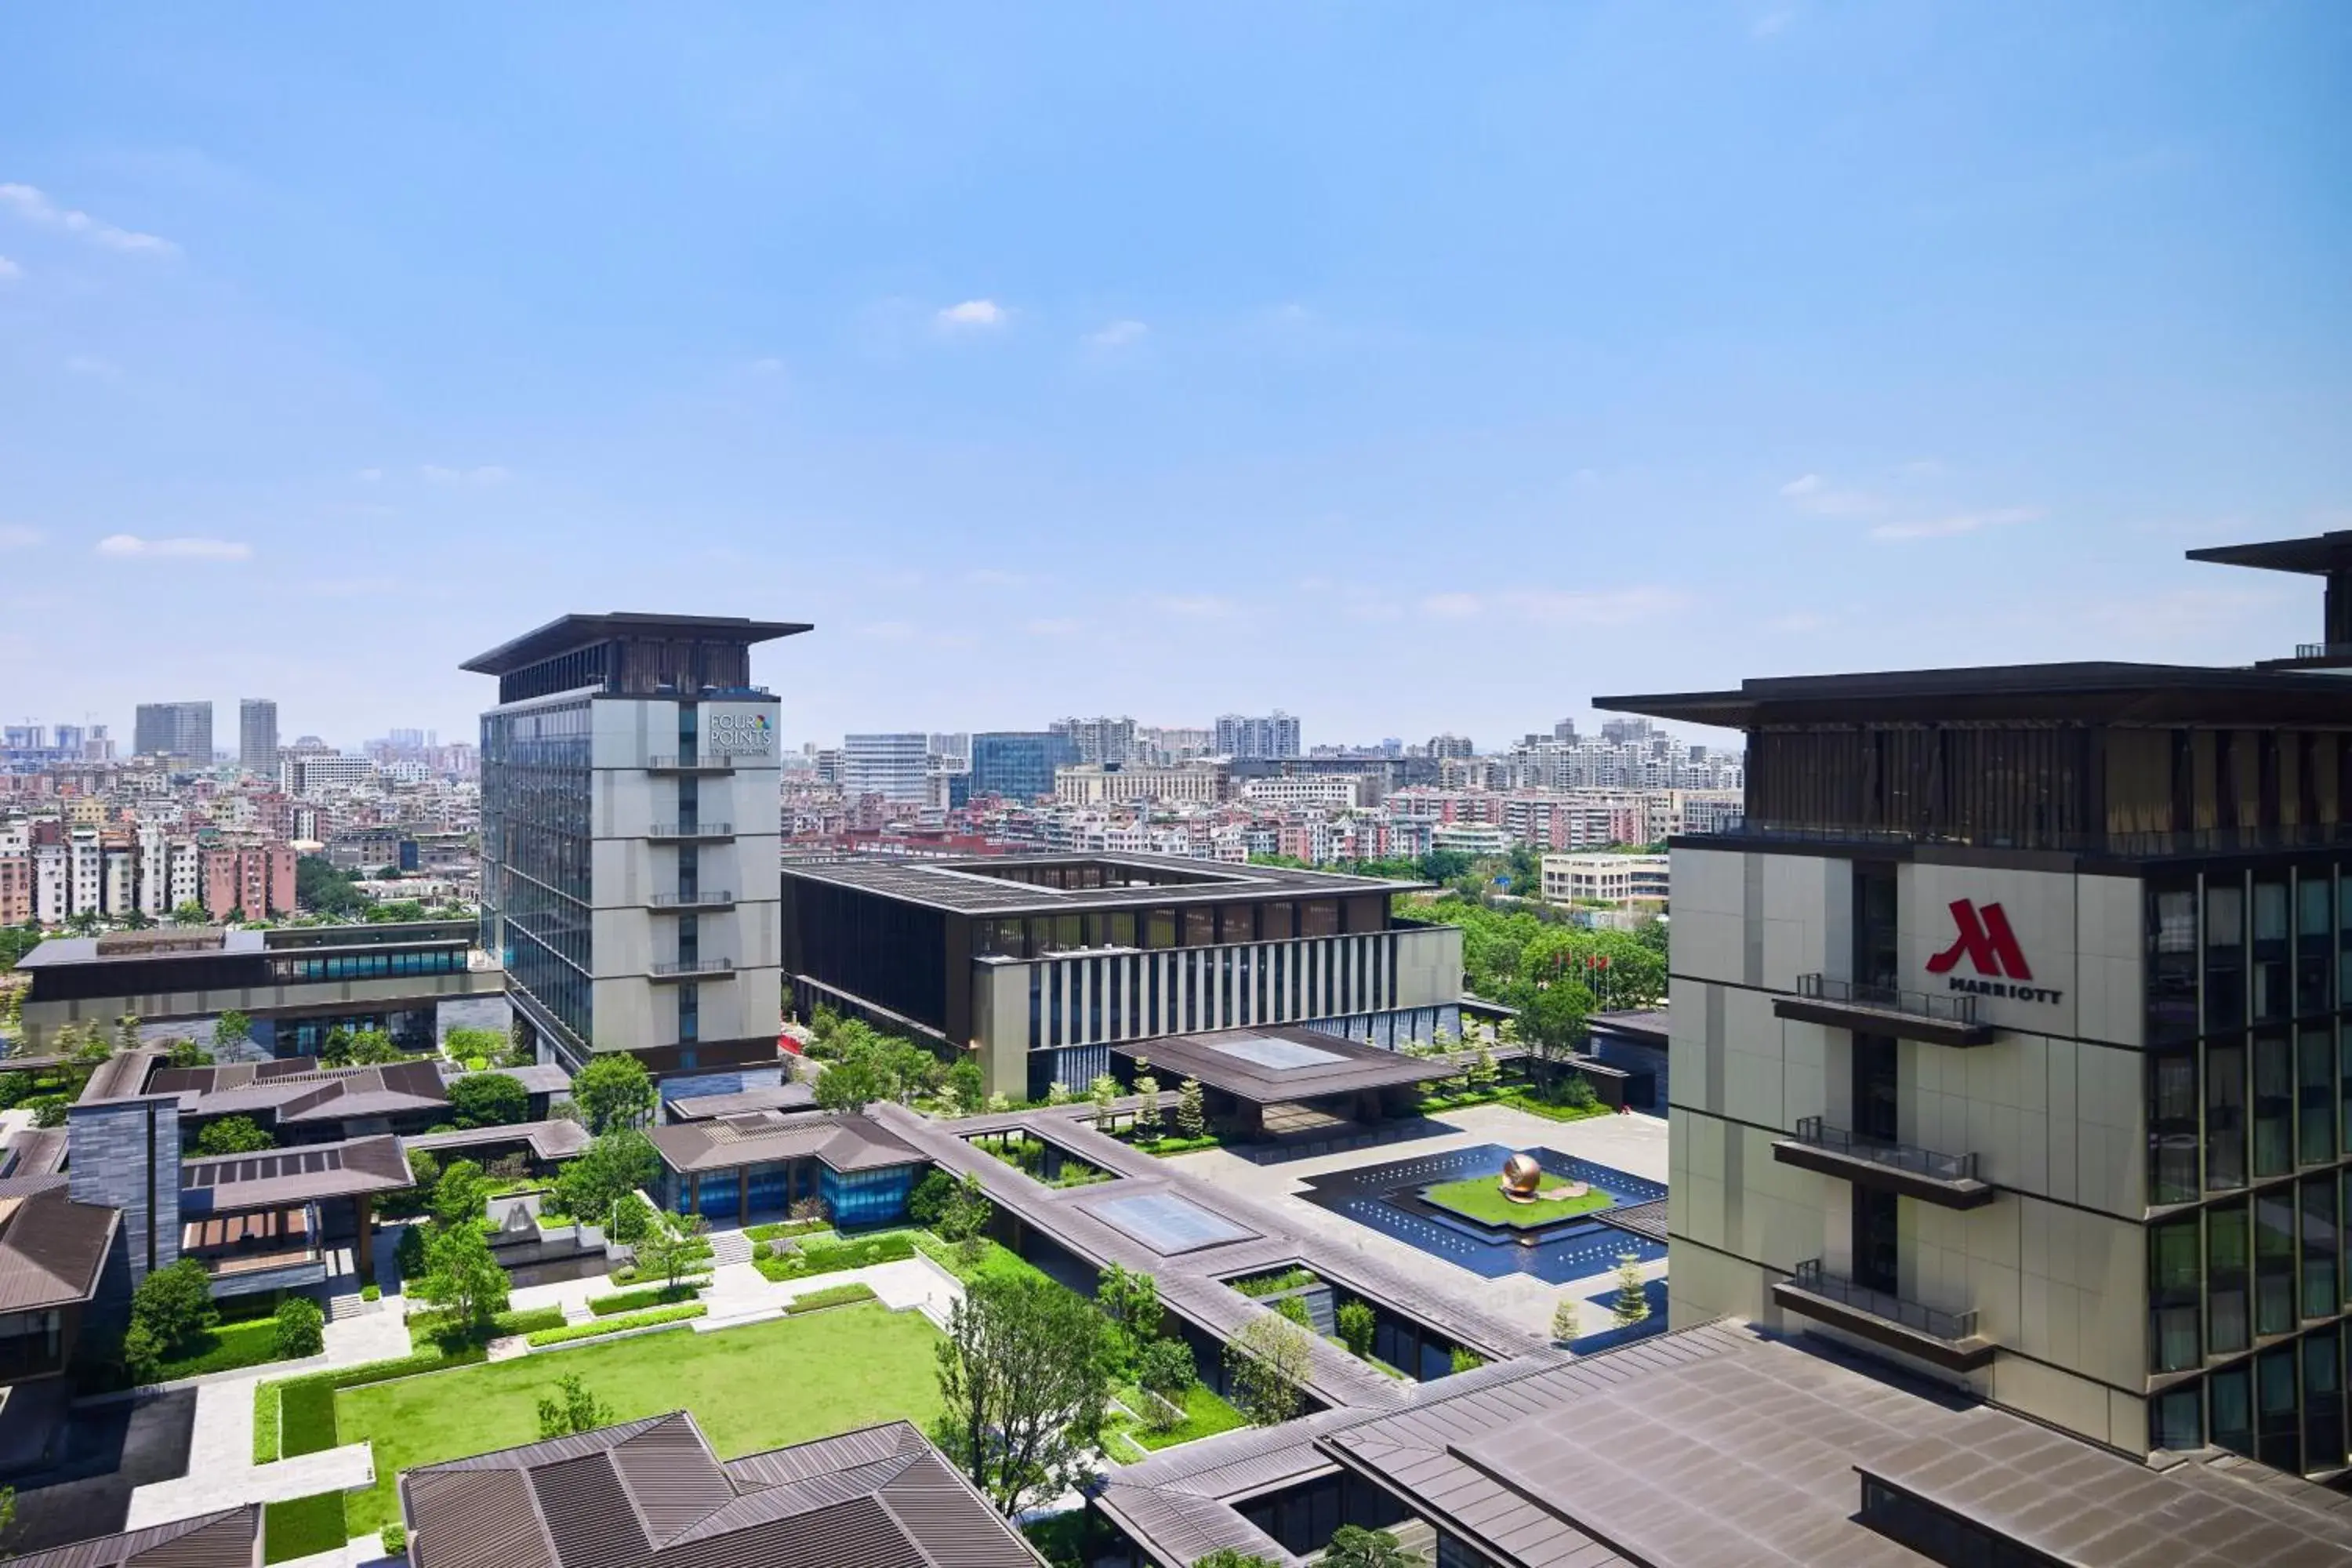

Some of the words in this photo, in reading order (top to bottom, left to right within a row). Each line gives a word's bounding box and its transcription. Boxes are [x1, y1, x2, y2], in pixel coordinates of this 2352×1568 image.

[711, 714, 755, 728] FOUR
[711, 730, 771, 746] POINTS
[1949, 977, 2063, 1004] MARRIOTT
